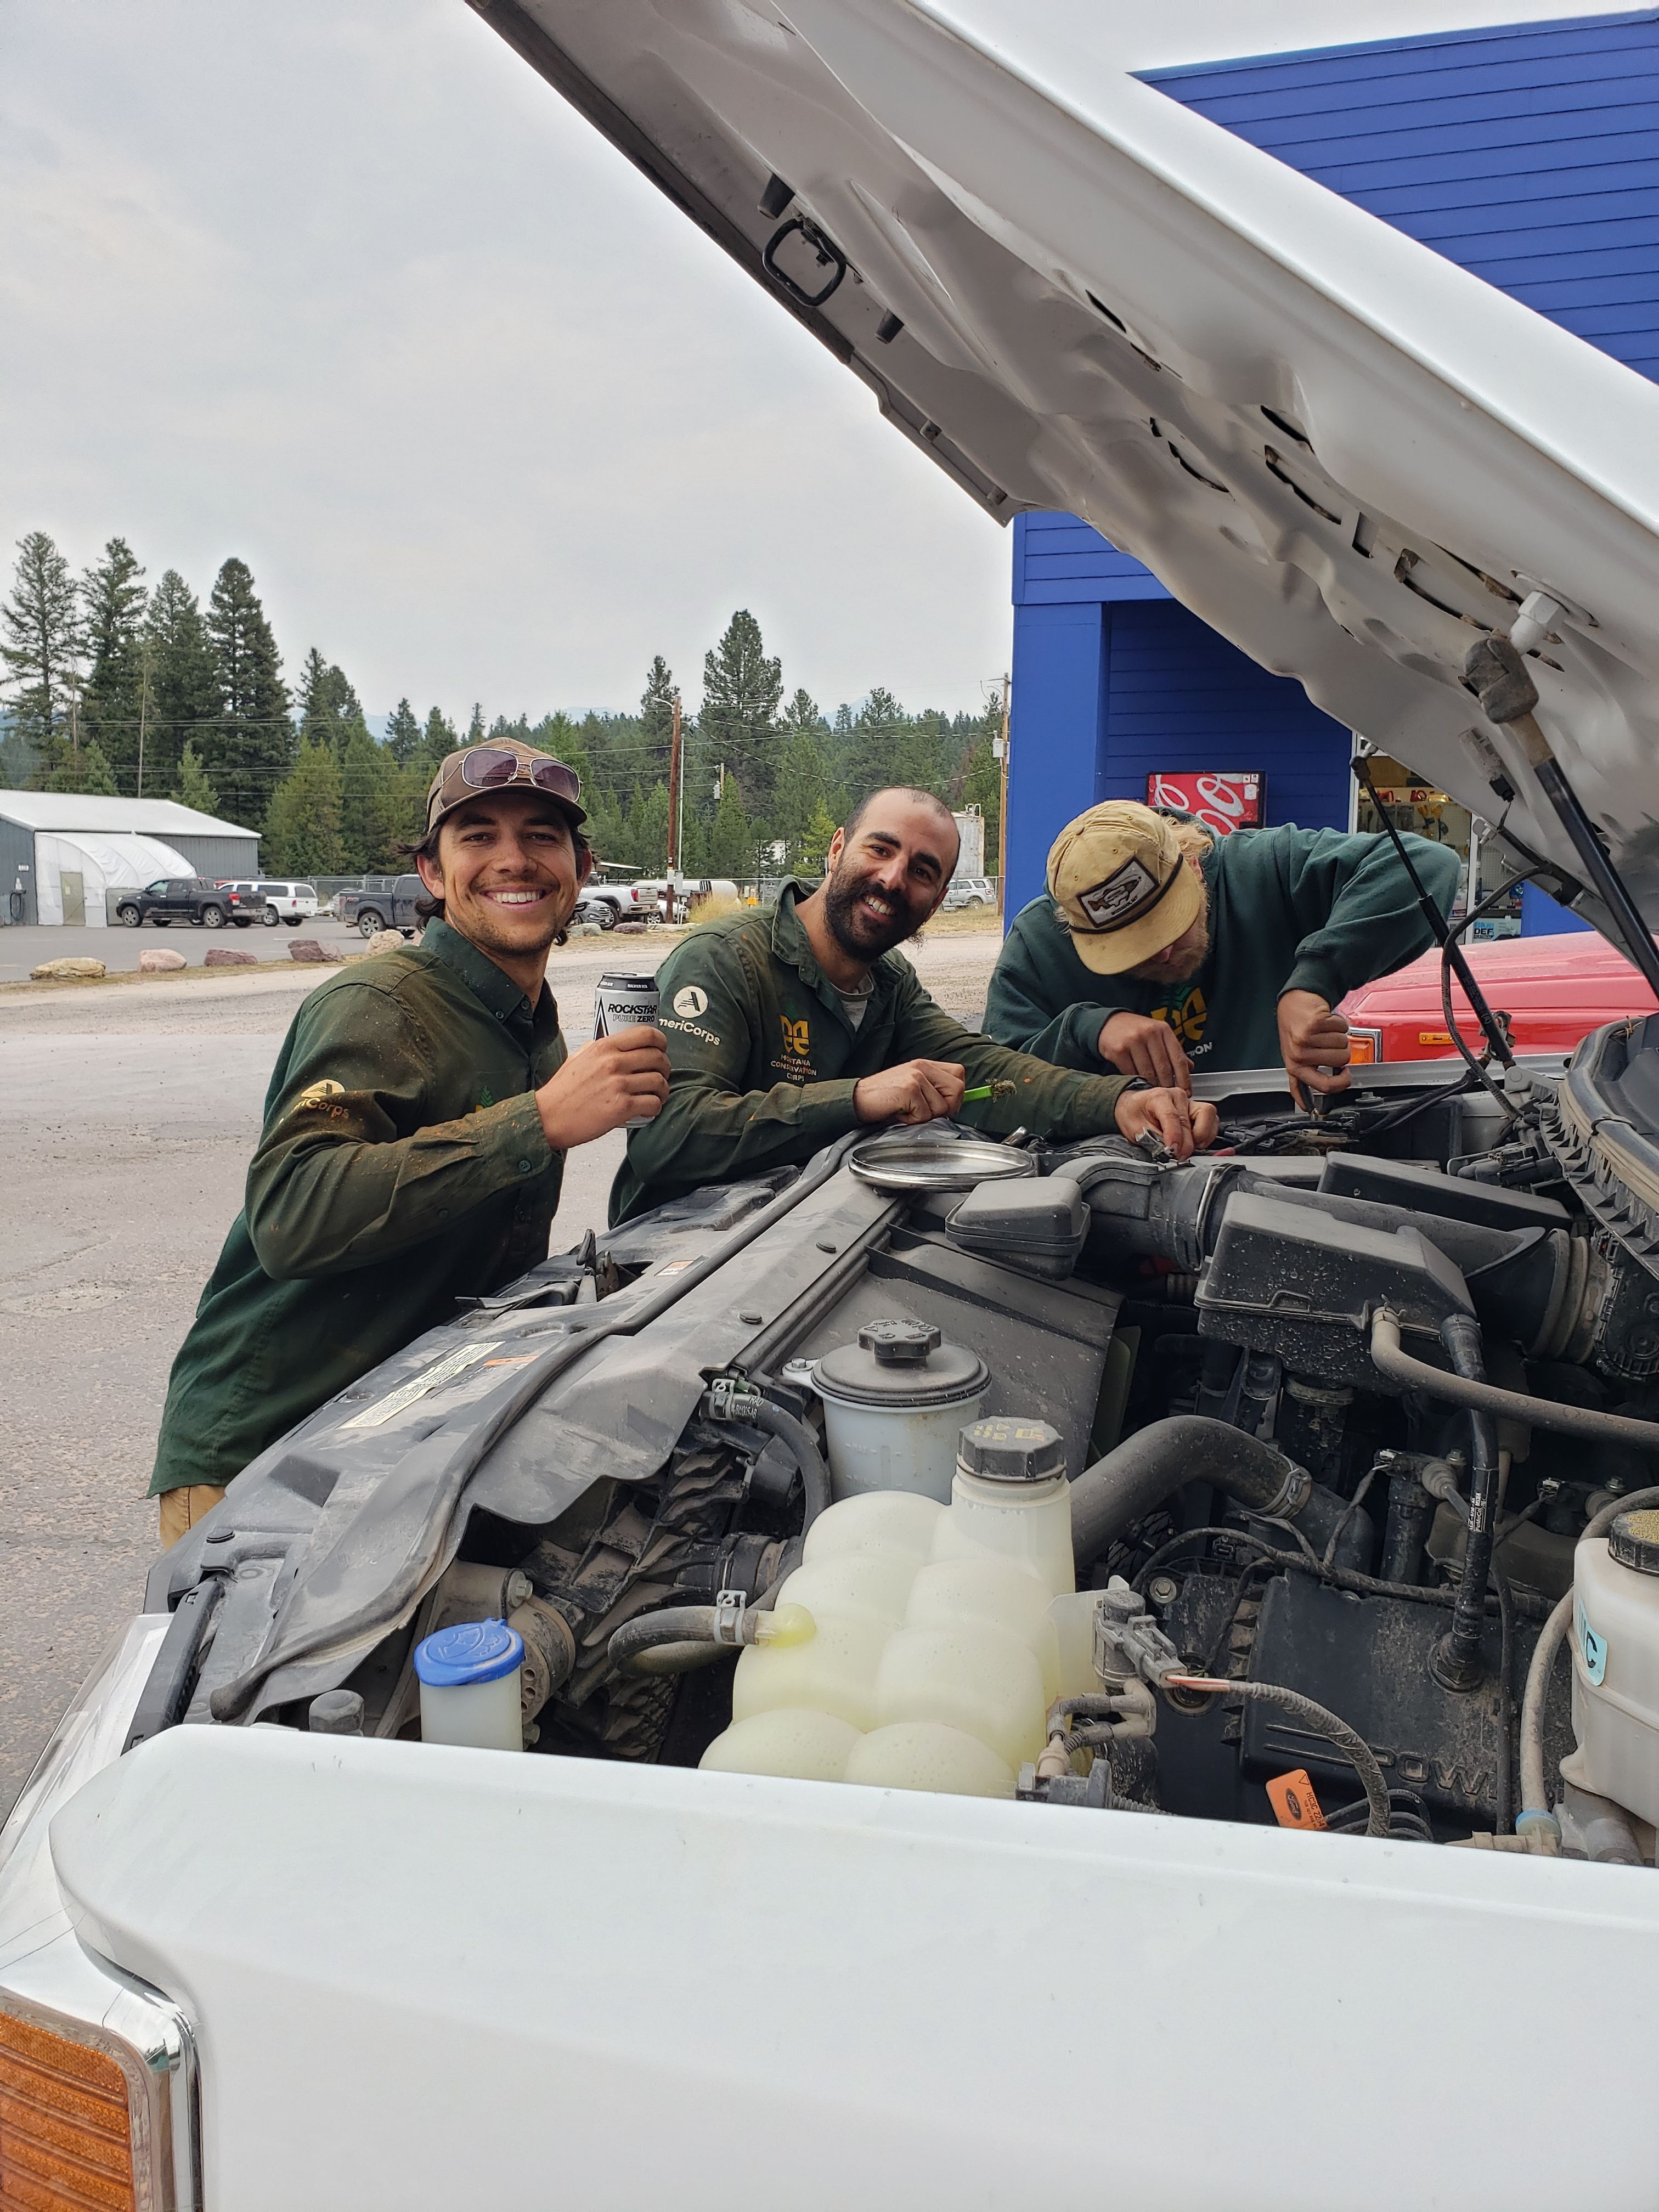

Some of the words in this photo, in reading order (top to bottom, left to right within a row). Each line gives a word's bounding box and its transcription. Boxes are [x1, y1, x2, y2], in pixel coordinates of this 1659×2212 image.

[608, 1003, 658, 1014] ROCKSTAR
[613, 1014, 635, 1022] PURE
[658, 1018, 720, 1046] meriCorps
[749, 1395, 764, 1407] RAD
[1306, 1792, 1318, 1810] HC3C
